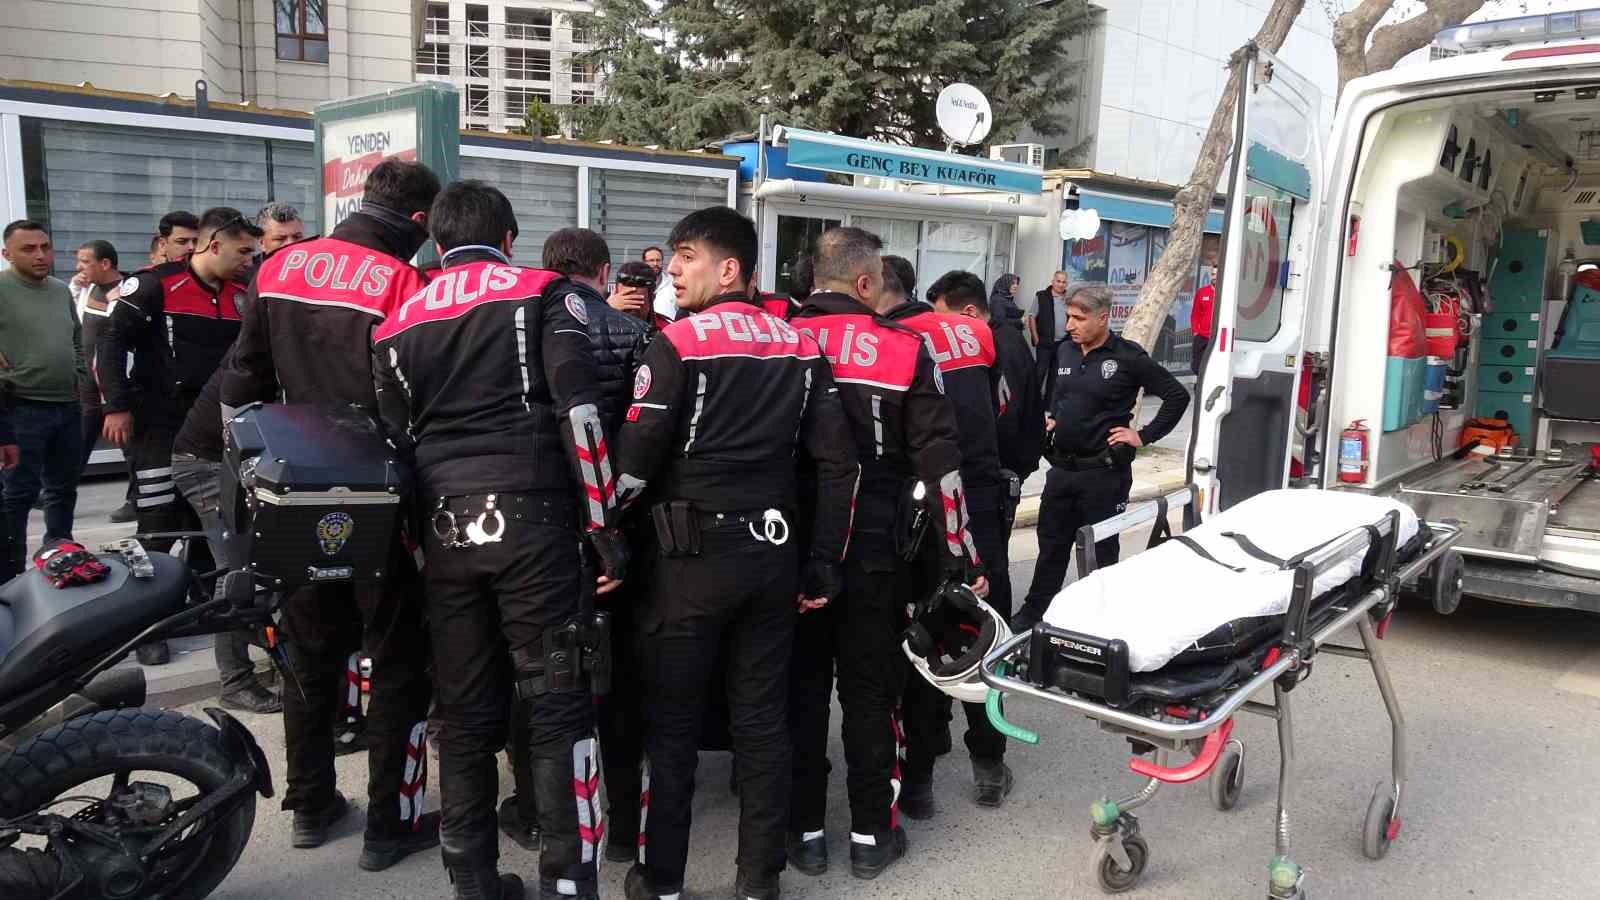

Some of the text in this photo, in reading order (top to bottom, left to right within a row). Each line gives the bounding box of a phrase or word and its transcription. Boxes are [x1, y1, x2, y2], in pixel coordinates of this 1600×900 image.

[847, 152, 998, 186] GENÇ BEY KUAFÖR
[278, 249, 393, 297] POLİS
[800, 323, 880, 367] LİS
[919, 321, 981, 364] LİS
[1049, 637, 1102, 655] SPENCER
